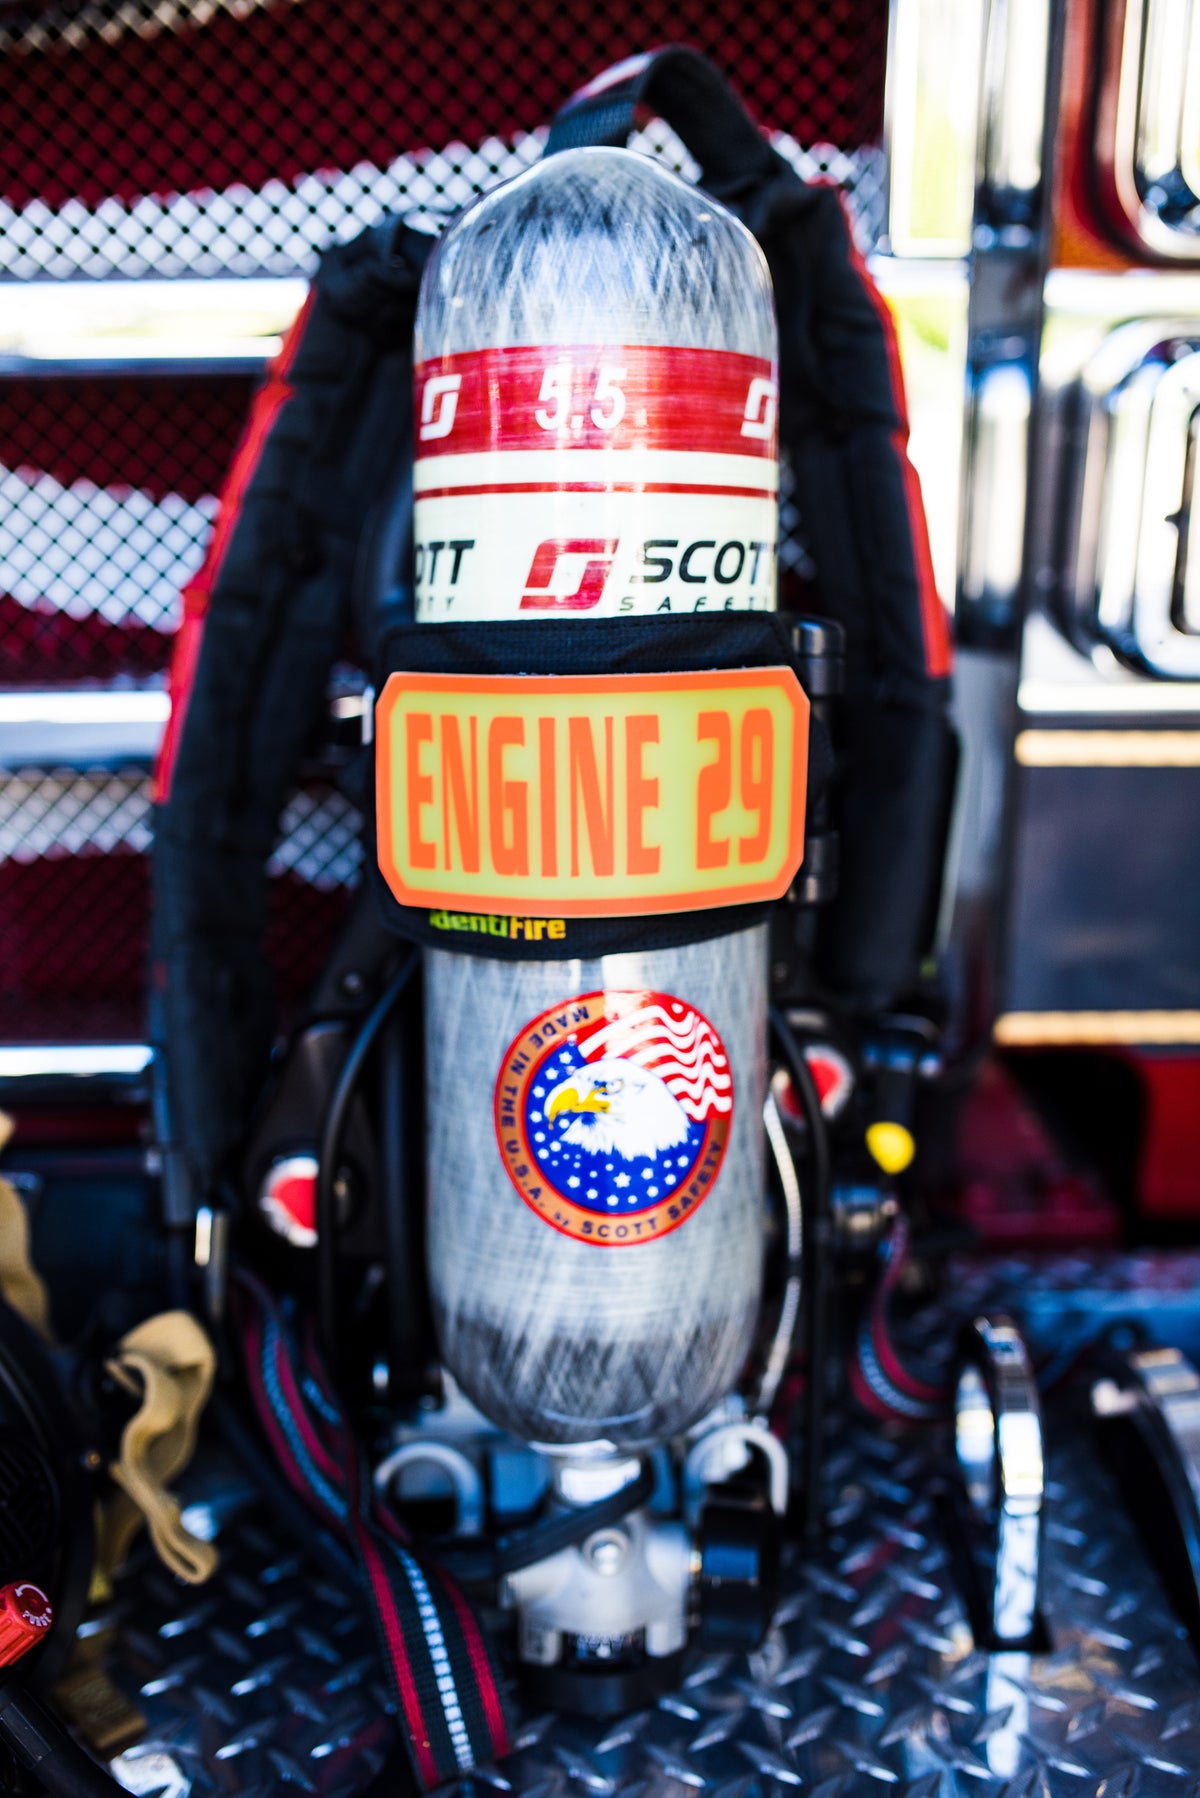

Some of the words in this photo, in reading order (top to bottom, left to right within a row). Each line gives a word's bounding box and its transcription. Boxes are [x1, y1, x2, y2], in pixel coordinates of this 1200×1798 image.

[534, 365, 626, 432] 5.5
[405, 712, 660, 878] ENGINE
[696, 708, 774, 870] 29
[529, 1005, 589, 1049] MADE
[510, 1052, 530, 1076] IN
[501, 1085, 518, 1127] THE
[668, 1141, 722, 1219] SAFETY
[581, 1217, 657, 1238] SCOTT
